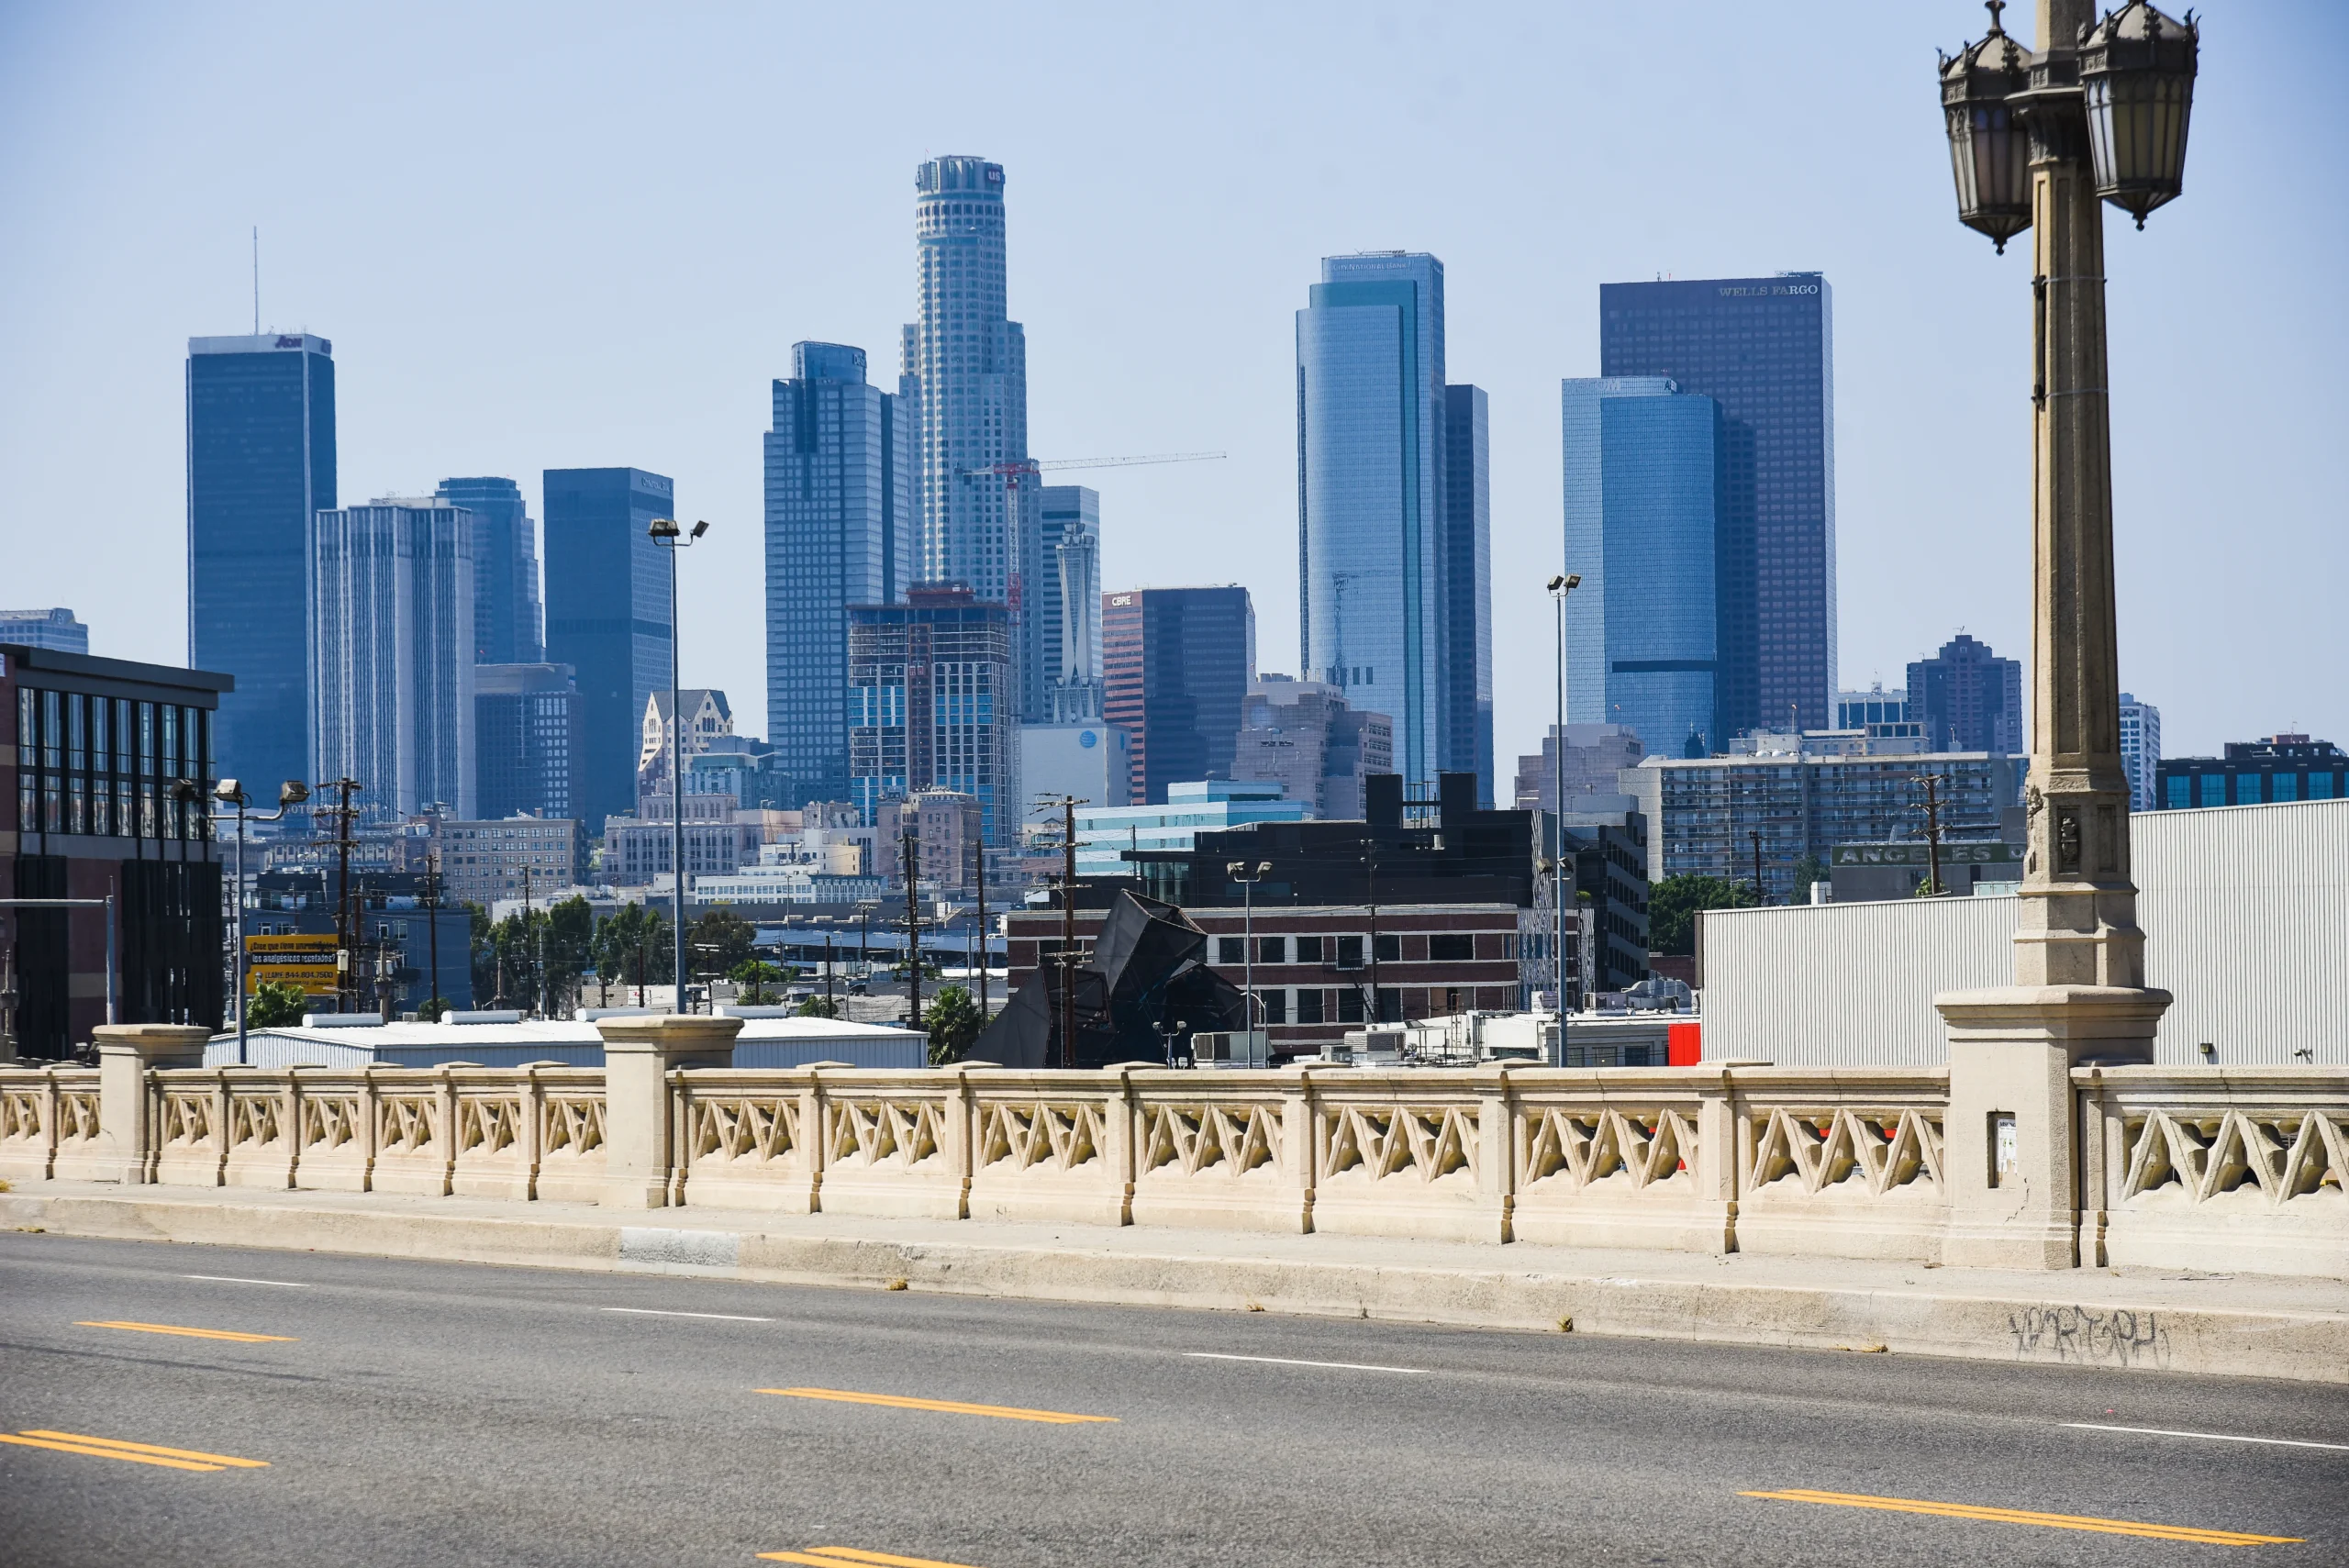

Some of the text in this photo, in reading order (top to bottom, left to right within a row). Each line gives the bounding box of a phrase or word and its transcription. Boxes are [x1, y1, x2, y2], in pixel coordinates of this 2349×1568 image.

[1719, 284, 1819, 297] WELLS FARGO
[1111, 595, 1132, 606] CBRE
[252, 954, 262, 963] los
[262, 954, 301, 964] analgésicos
